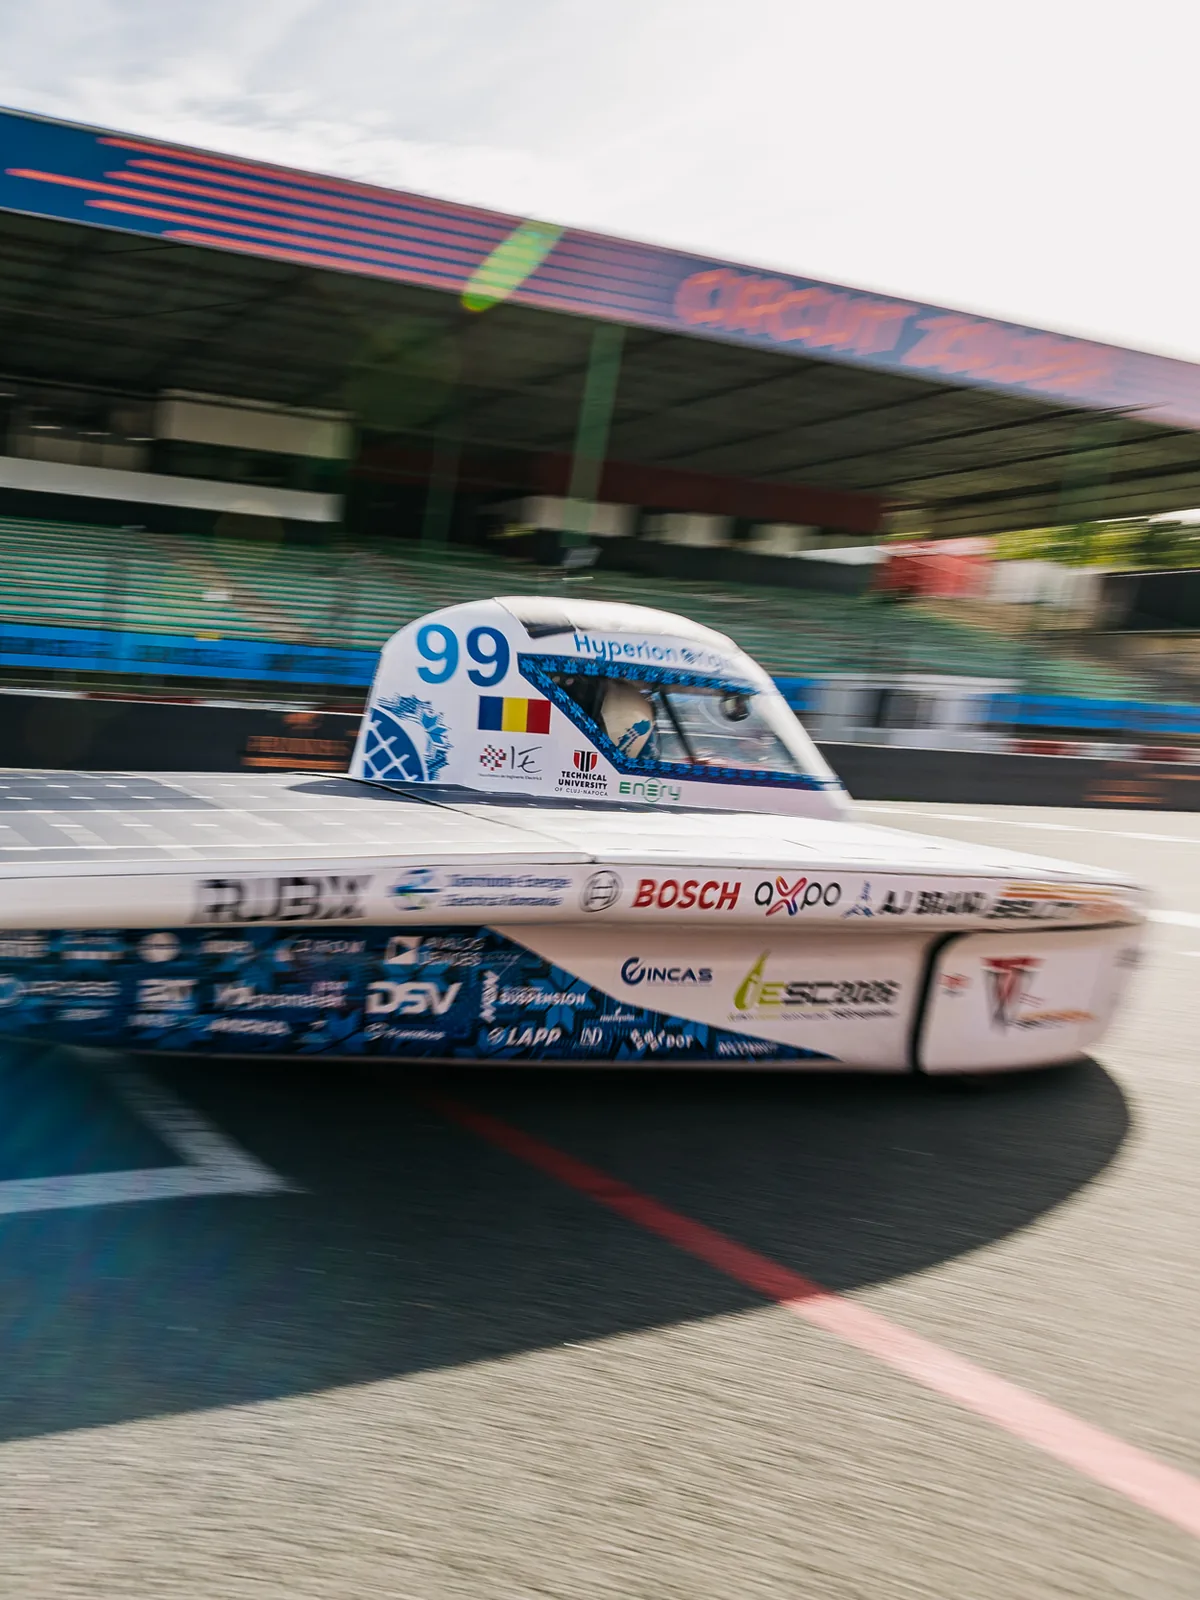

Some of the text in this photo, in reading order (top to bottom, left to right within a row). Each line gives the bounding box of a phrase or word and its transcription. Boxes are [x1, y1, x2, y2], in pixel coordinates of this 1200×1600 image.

[416, 624, 510, 687] 99
[573, 634, 679, 663] Hyperion
[558, 779, 608, 790] UNIVERSITY
[561, 770, 607, 781] TECHNICAL
[566, 788, 609, 796] CLUJ-NAPOCA
[632, 878, 741, 910] BOSCH
[755, 876, 841, 916] axpo
[647, 967, 713, 982] INCAS
[365, 981, 463, 1015] DSV
[500, 992, 587, 1006] SUSPENSION
[505, 1027, 561, 1047] LAPP
